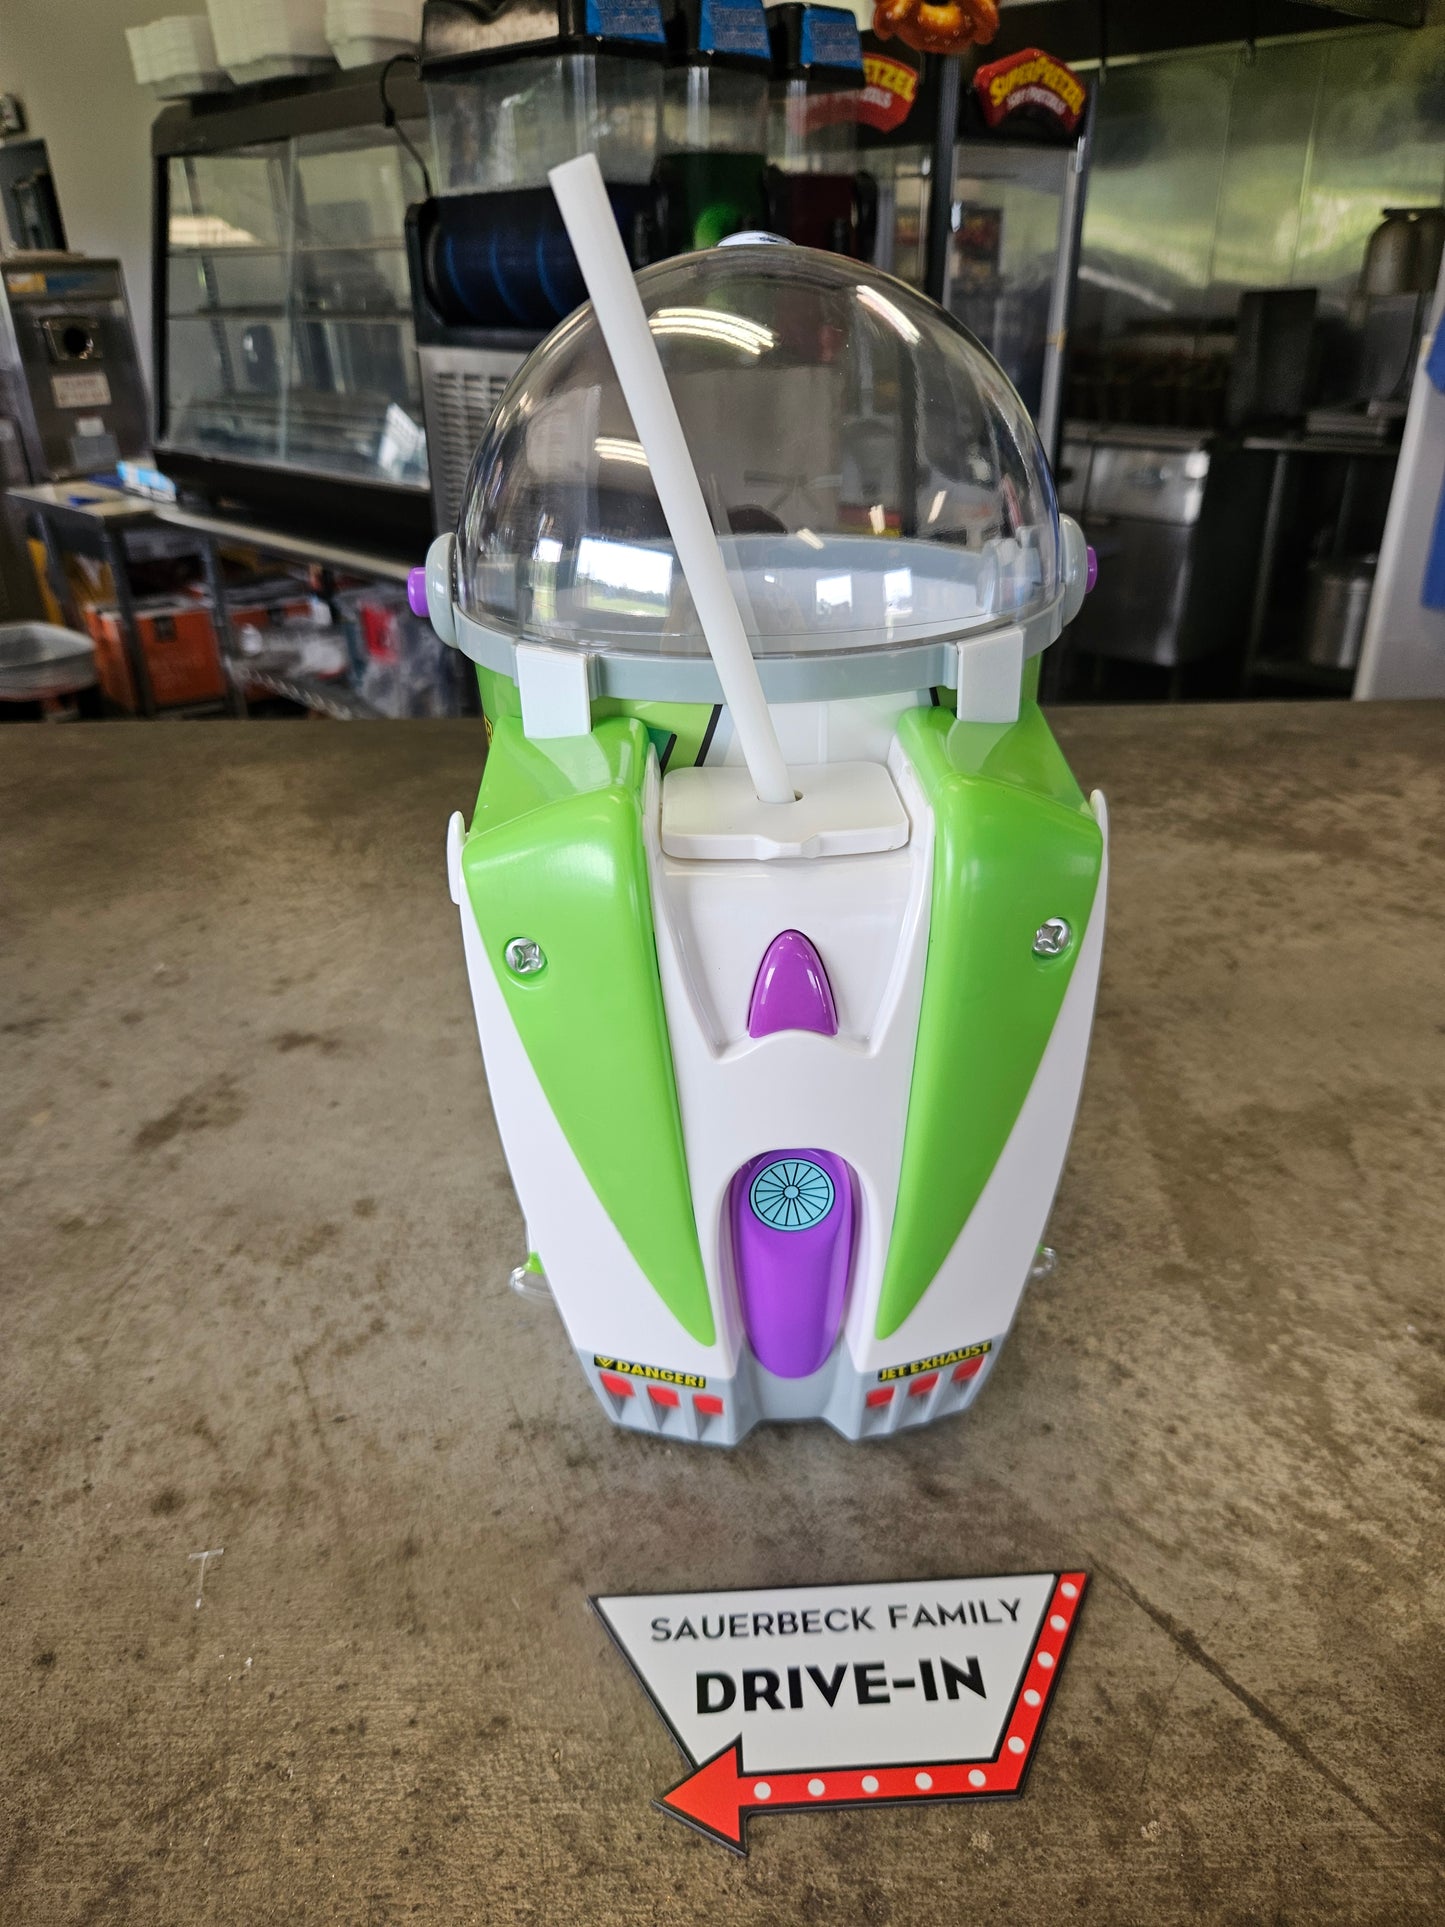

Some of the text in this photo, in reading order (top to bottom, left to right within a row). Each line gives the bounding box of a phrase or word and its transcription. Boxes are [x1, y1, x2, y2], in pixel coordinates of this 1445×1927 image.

[616, 1359, 705, 1388] DANGER!
[880, 1340, 990, 1382] JET EXHAUST
[651, 1598, 1021, 1642] SAUERBECK FAMILY
[696, 1656, 987, 1715] DRIVE-IN
